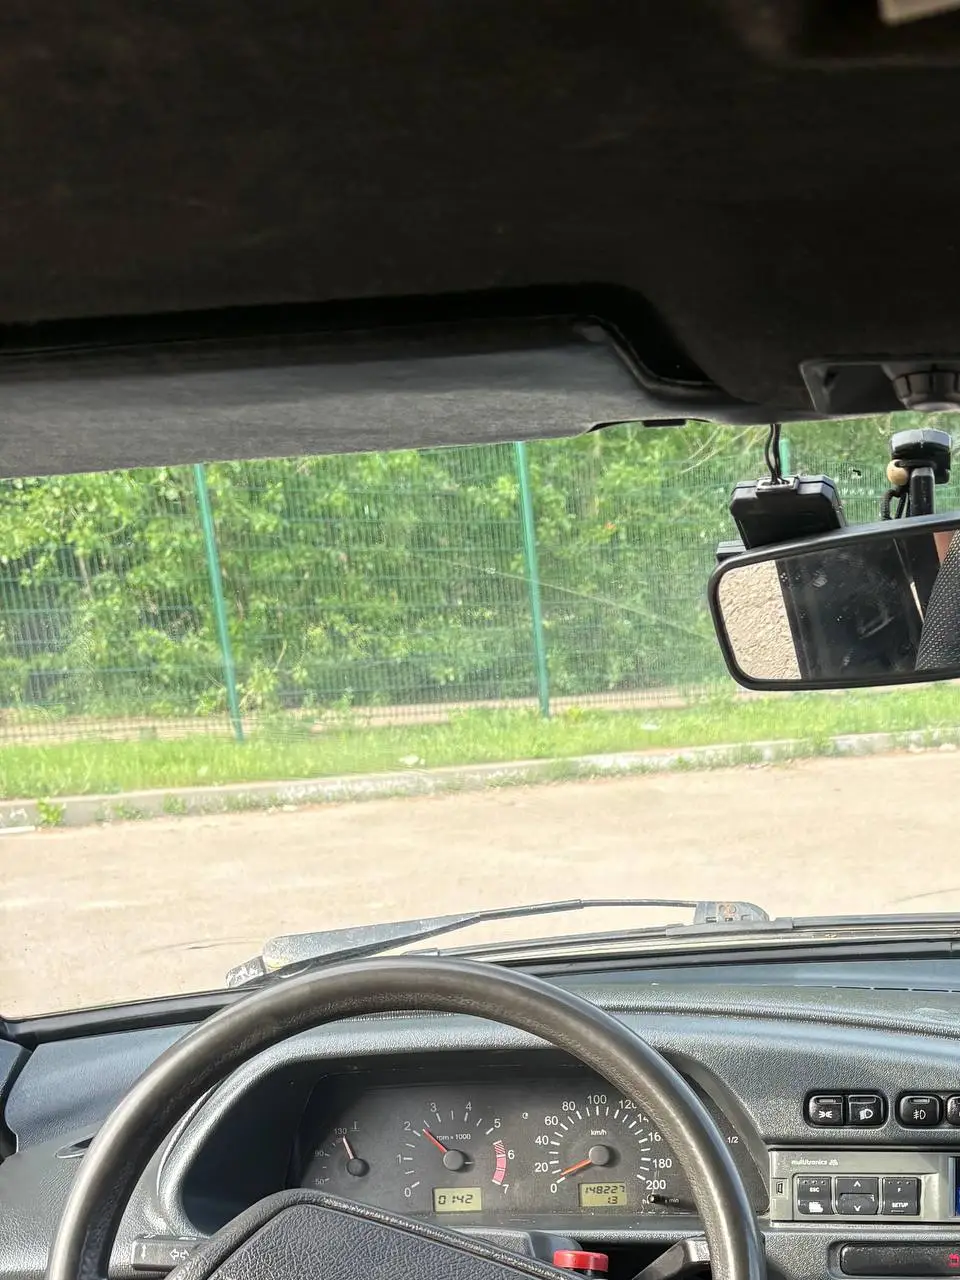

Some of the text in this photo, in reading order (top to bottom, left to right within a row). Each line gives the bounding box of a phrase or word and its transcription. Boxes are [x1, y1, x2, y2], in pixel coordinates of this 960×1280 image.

[587, 1095, 607, 1105] 100
[430, 1103, 437, 1112] 3
[465, 1101, 472, 1111] 4
[562, 1101, 576, 1111] 80
[404, 1121, 412, 1131] 2
[494, 1119, 501, 1128] 5
[544, 1116, 558, 1126] 60
[535, 1135, 549, 1145] 40
[648, 1132, 663, 1142] 16
[727, 1136, 739, 1144] 1/2
[396, 1153, 402, 1164] 1
[508, 1150, 515, 1160] 6
[535, 1162, 549, 1172] 20
[653, 1159, 672, 1169] 180
[502, 1184, 509, 1194] 7
[550, 1183, 558, 1193] 0
[646, 1180, 666, 1190] 200
[404, 1187, 412, 1198] 0
